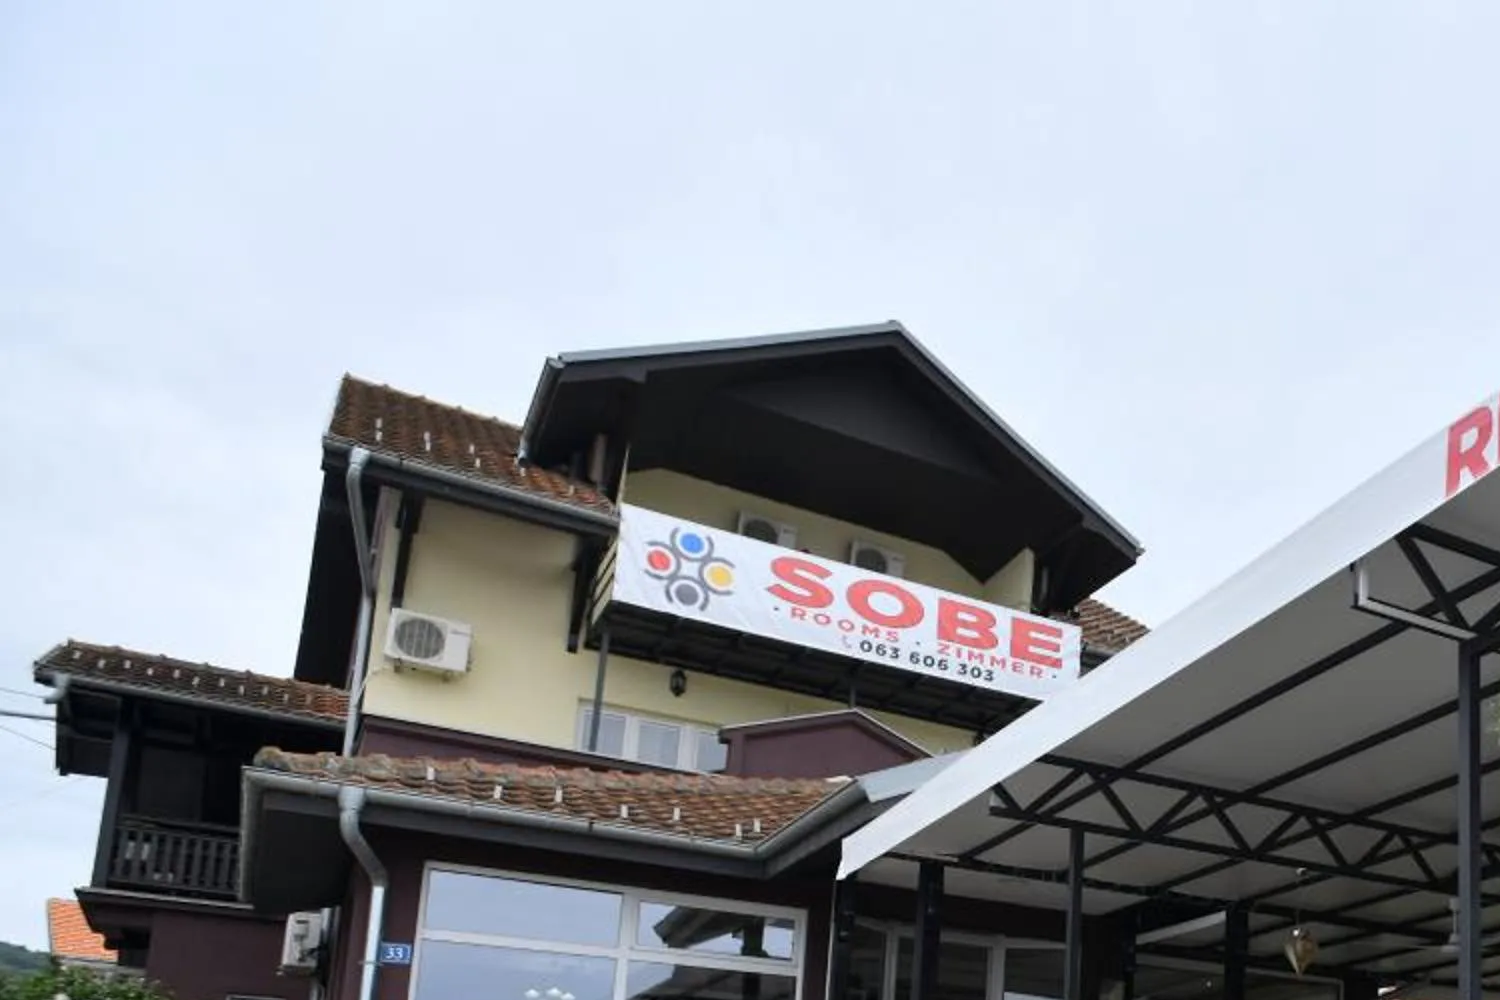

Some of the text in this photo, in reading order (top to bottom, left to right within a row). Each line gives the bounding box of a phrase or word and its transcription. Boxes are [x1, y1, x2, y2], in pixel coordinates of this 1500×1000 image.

[766, 556, 1063, 669] SOBE
[791, 606, 1044, 679] ROOMS ZIMMER
[860, 639, 994, 682] 063 606 303
